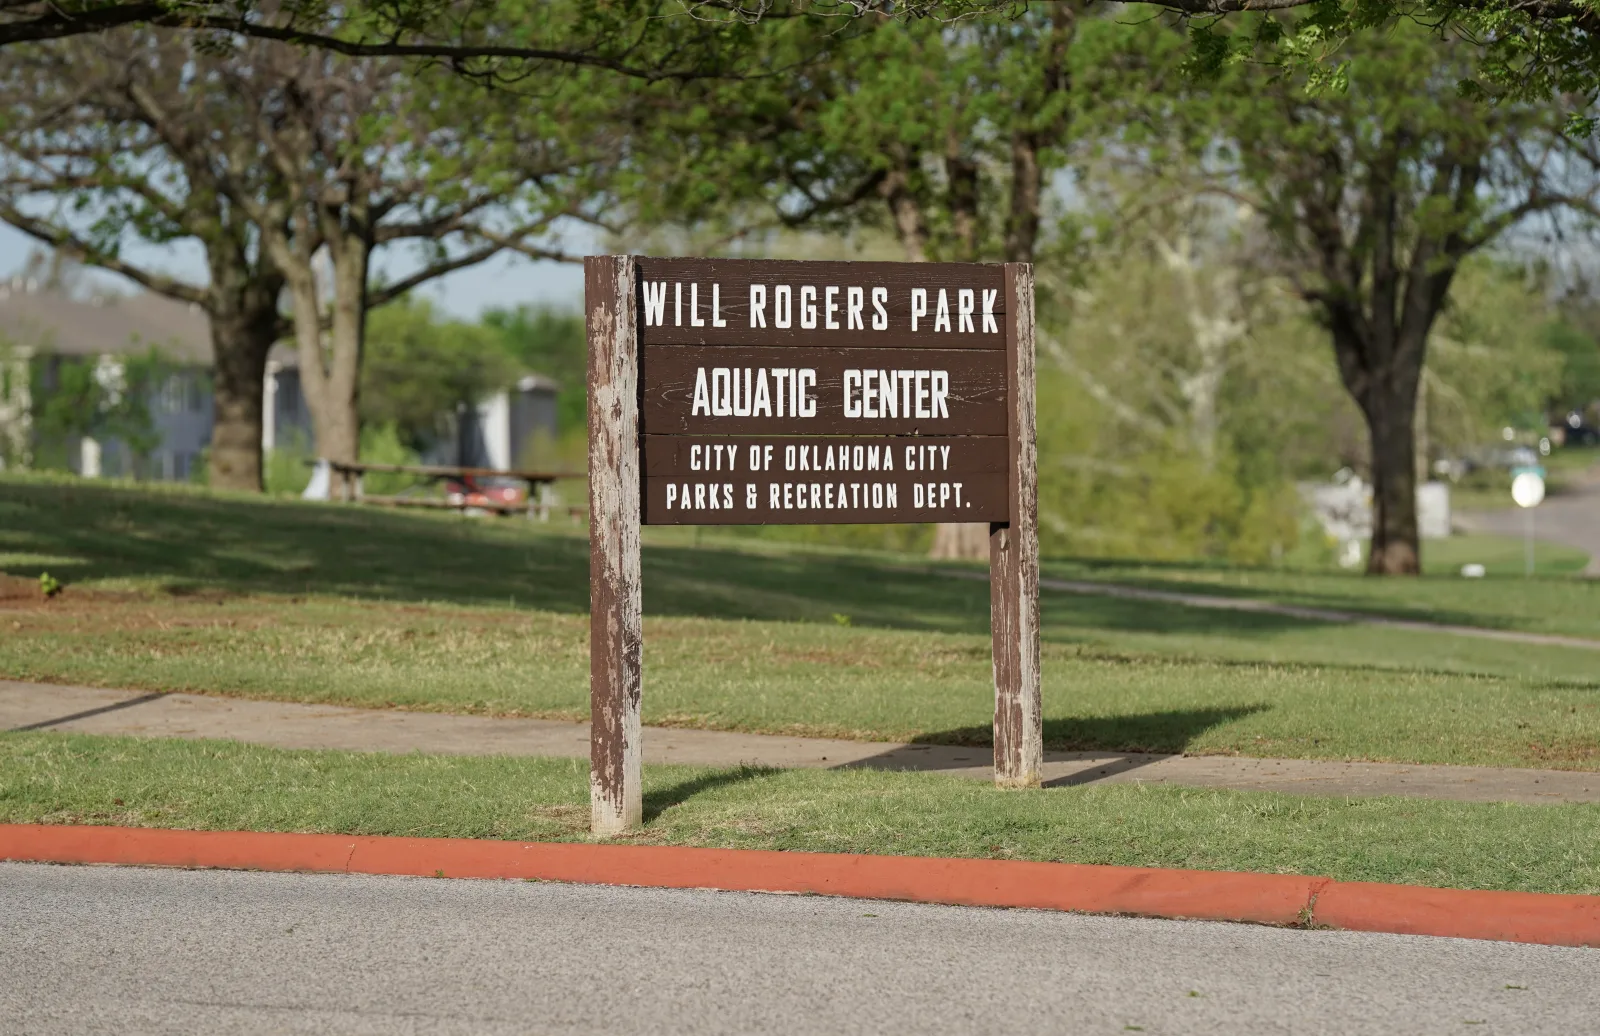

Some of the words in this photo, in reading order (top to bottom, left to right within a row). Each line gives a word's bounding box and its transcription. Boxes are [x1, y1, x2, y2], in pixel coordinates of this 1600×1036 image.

[642, 281, 727, 328] WILL
[749, 284, 888, 331] ROGERS
[911, 287, 999, 334] PARK
[691, 367, 817, 418] AQUATIC
[843, 369, 949, 419] CENTER
[690, 444, 738, 471] CITY
[749, 444, 774, 471] OF
[785, 445, 894, 471] OKLAHOMA
[905, 445, 951, 471] CITY
[666, 483, 734, 510] PARKS
[746, 483, 758, 509] &
[769, 482, 898, 509] RECREATION
[913, 482, 972, 509] DEPT.
